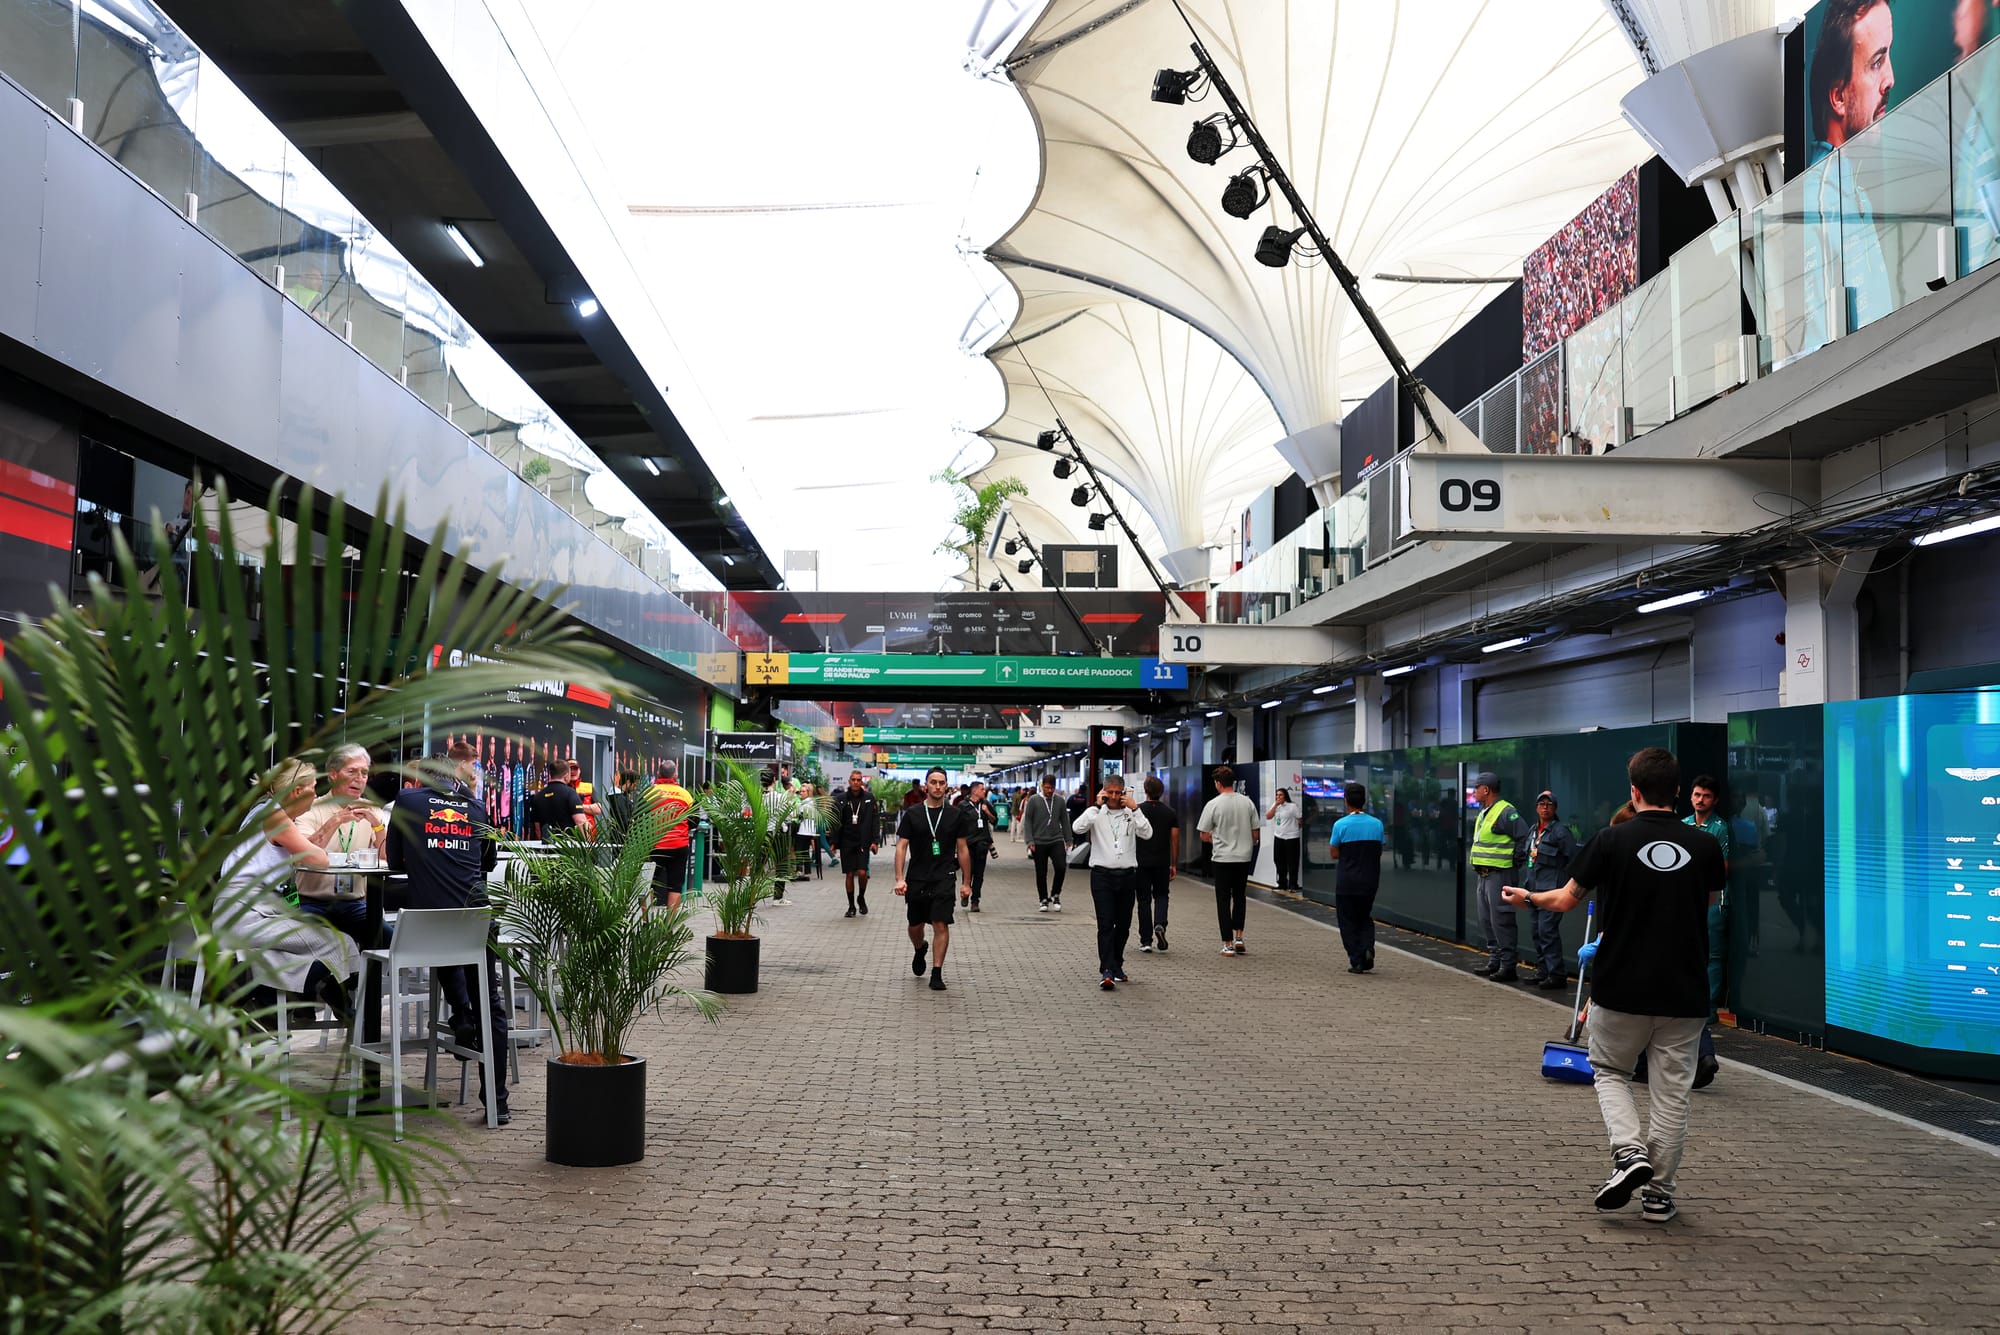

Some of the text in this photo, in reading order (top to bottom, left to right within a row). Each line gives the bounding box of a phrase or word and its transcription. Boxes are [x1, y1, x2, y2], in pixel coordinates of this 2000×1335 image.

[1440, 479, 1501, 512] 09
[889, 611, 917, 620] LVMH
[1173, 636, 1202, 652] 10
[756, 665, 779, 674] 3,1M
[1022, 667, 1057, 676] BOTECO
[1067, 666, 1090, 676] CAFÉ
[1091, 668, 1133, 676] PADDOCK
[1153, 667, 1173, 679] 11
[1047, 715, 1061, 724] 12
[1024, 730, 1035, 738] 13
[745, 741, 774, 754] together
[428, 797, 469, 808] ORACLE
[425, 822, 472, 837] Red Bull
[427, 838, 459, 849] Mobil
